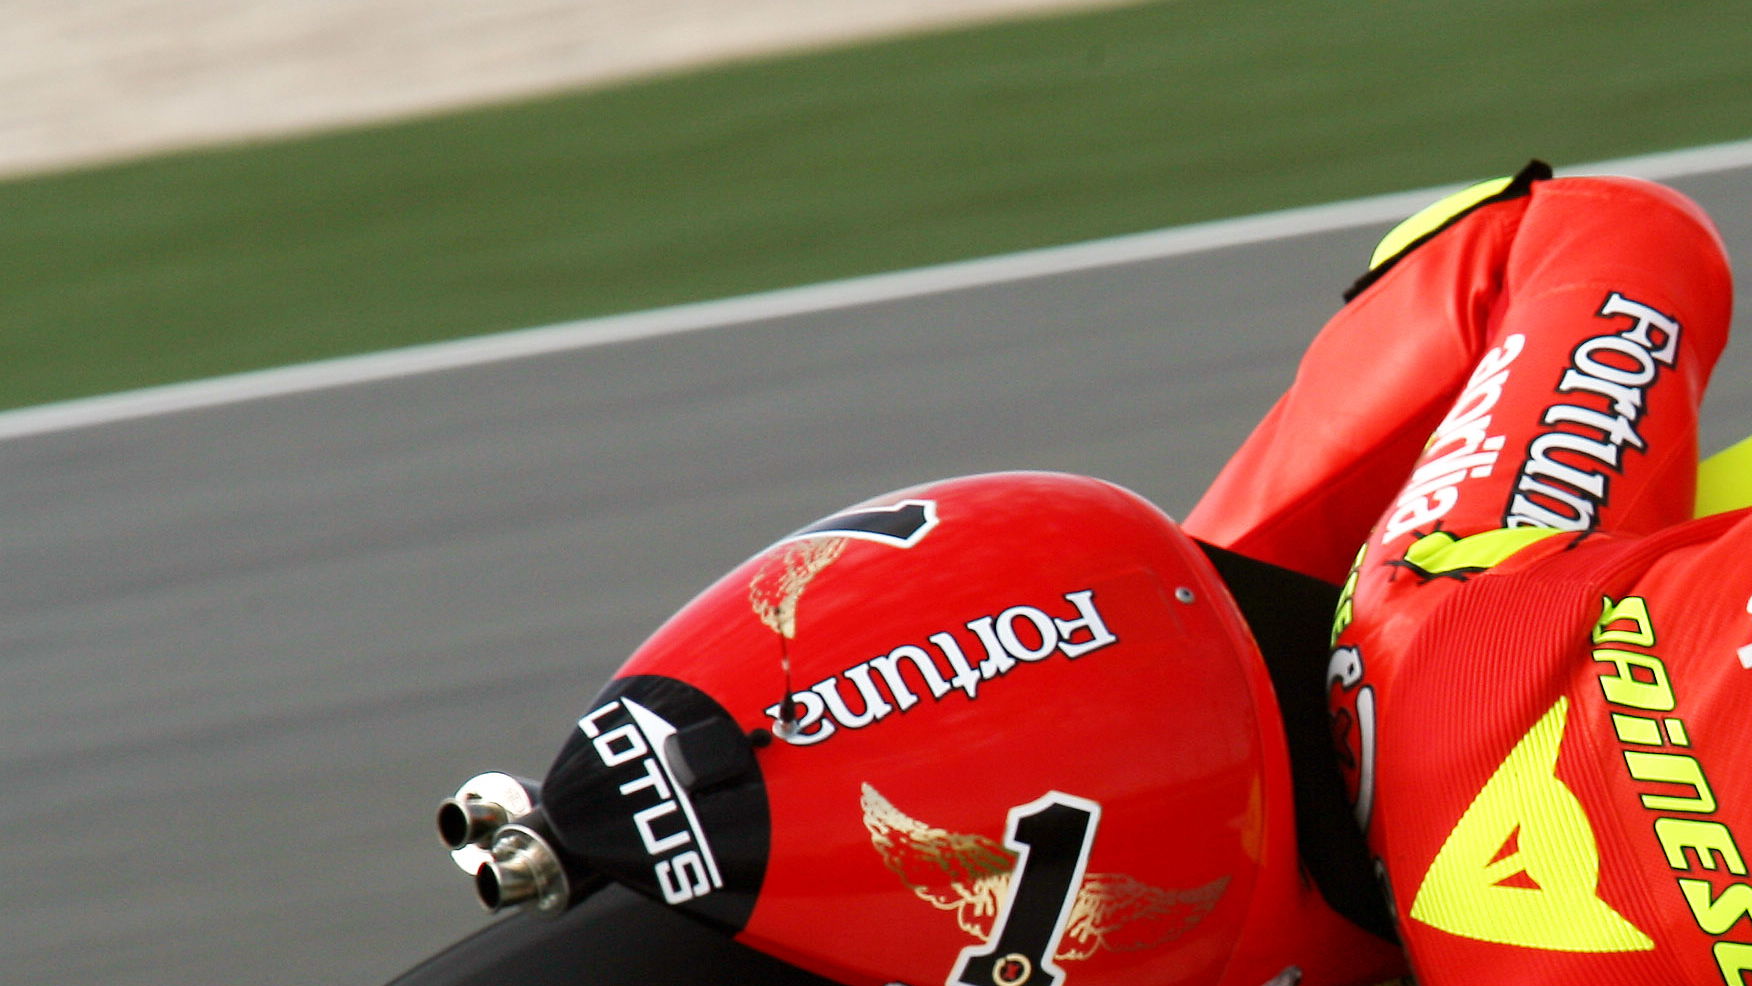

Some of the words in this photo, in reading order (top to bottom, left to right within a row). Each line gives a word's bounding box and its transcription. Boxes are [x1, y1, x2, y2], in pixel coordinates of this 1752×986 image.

[1381, 333, 1526, 545] aprilia
[1502, 290, 1684, 530] Fortun
[764, 590, 1118, 746] Fortuna
[577, 700, 712, 905] LOTUS
